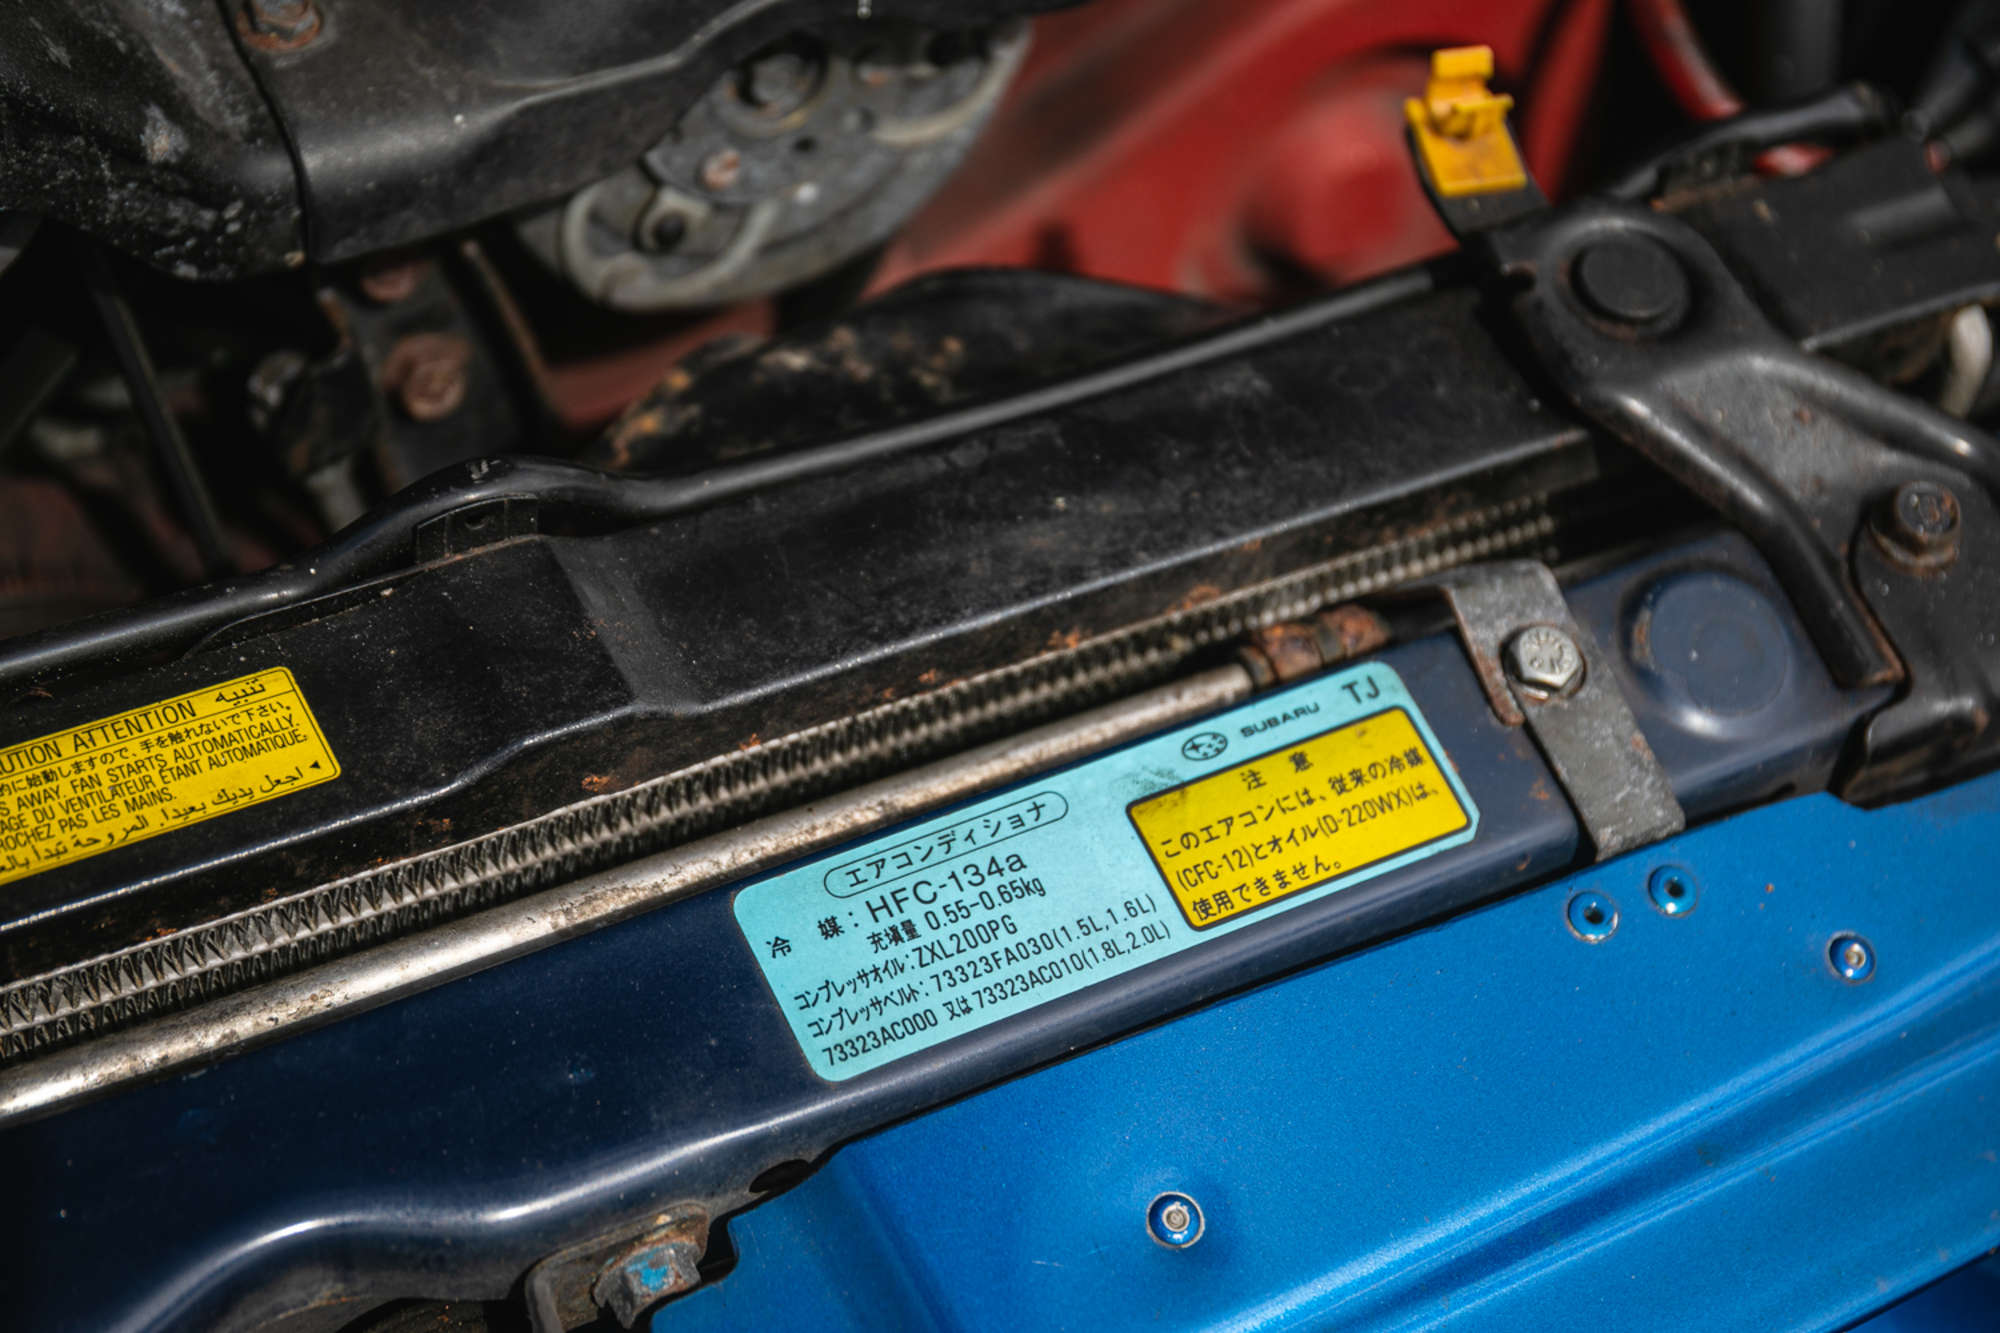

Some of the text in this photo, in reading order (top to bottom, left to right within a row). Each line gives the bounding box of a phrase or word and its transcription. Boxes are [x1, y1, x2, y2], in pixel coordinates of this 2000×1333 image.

[0, 700, 197, 776] UTION ATTENTION
[1240, 675, 1381, 738] SUBARU TJ
[16, 784, 66, 812] AWAY.
[70, 773, 103, 795] FAN
[106, 753, 168, 783] STARTS
[173, 713, 300, 764] AUTOMATICALLY.
[32, 806, 56, 824] DU
[58, 774, 157, 815] VENTILATEUR
[58, 812, 89, 834] PAS
[91, 803, 121, 824] LES
[123, 787, 177, 814] MAINS.
[845, 800, 1046, 888] エアコンディショナ
[765, 935, 792, 959] 冷
[865, 853, 1028, 923] HFC-134a
[1192, 854, 1342, 921] 使用できません。
[912, 914, 1018, 969] ZXL200PG
[822, 1008, 938, 1067] 73323AC000
